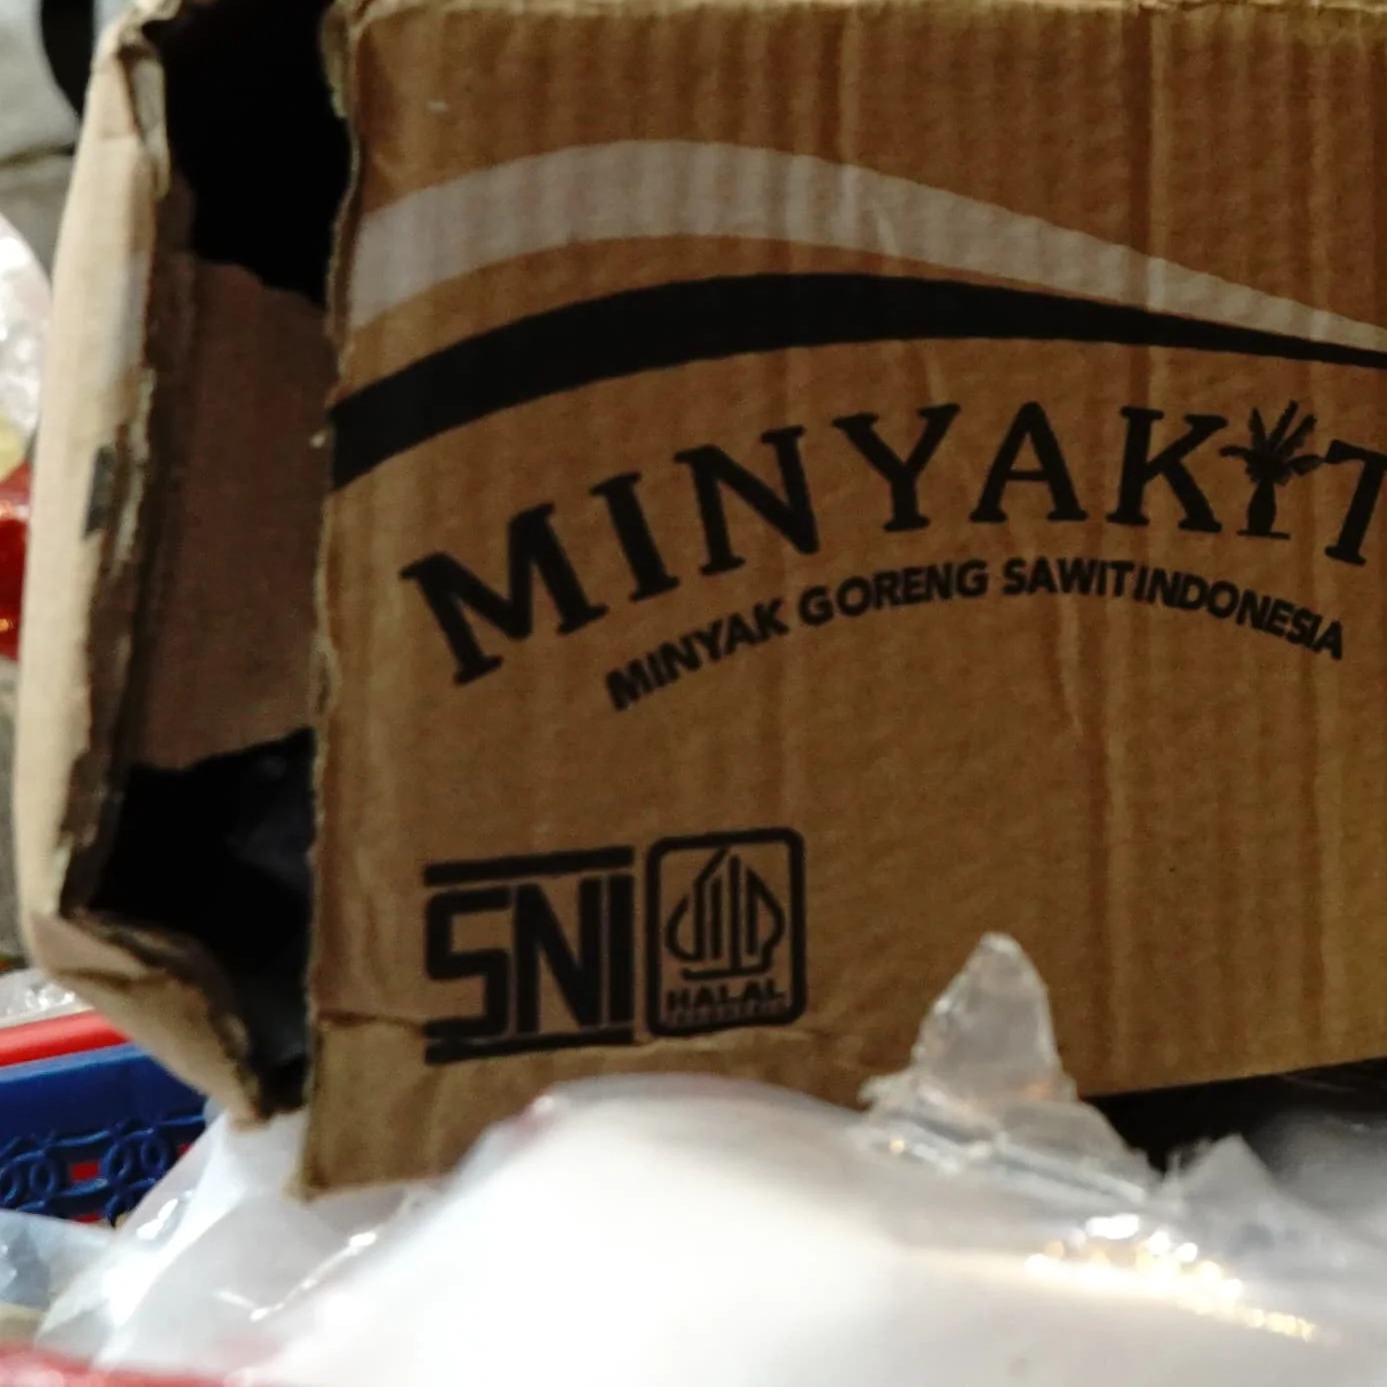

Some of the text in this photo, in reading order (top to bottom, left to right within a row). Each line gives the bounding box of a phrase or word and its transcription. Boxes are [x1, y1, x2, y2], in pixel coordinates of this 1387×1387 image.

[603, 555, 1347, 712] MINYAK GORENG SAWIT INDONESIA
[424, 869, 636, 1038] SNI
[667, 978, 784, 1011] HALAL
